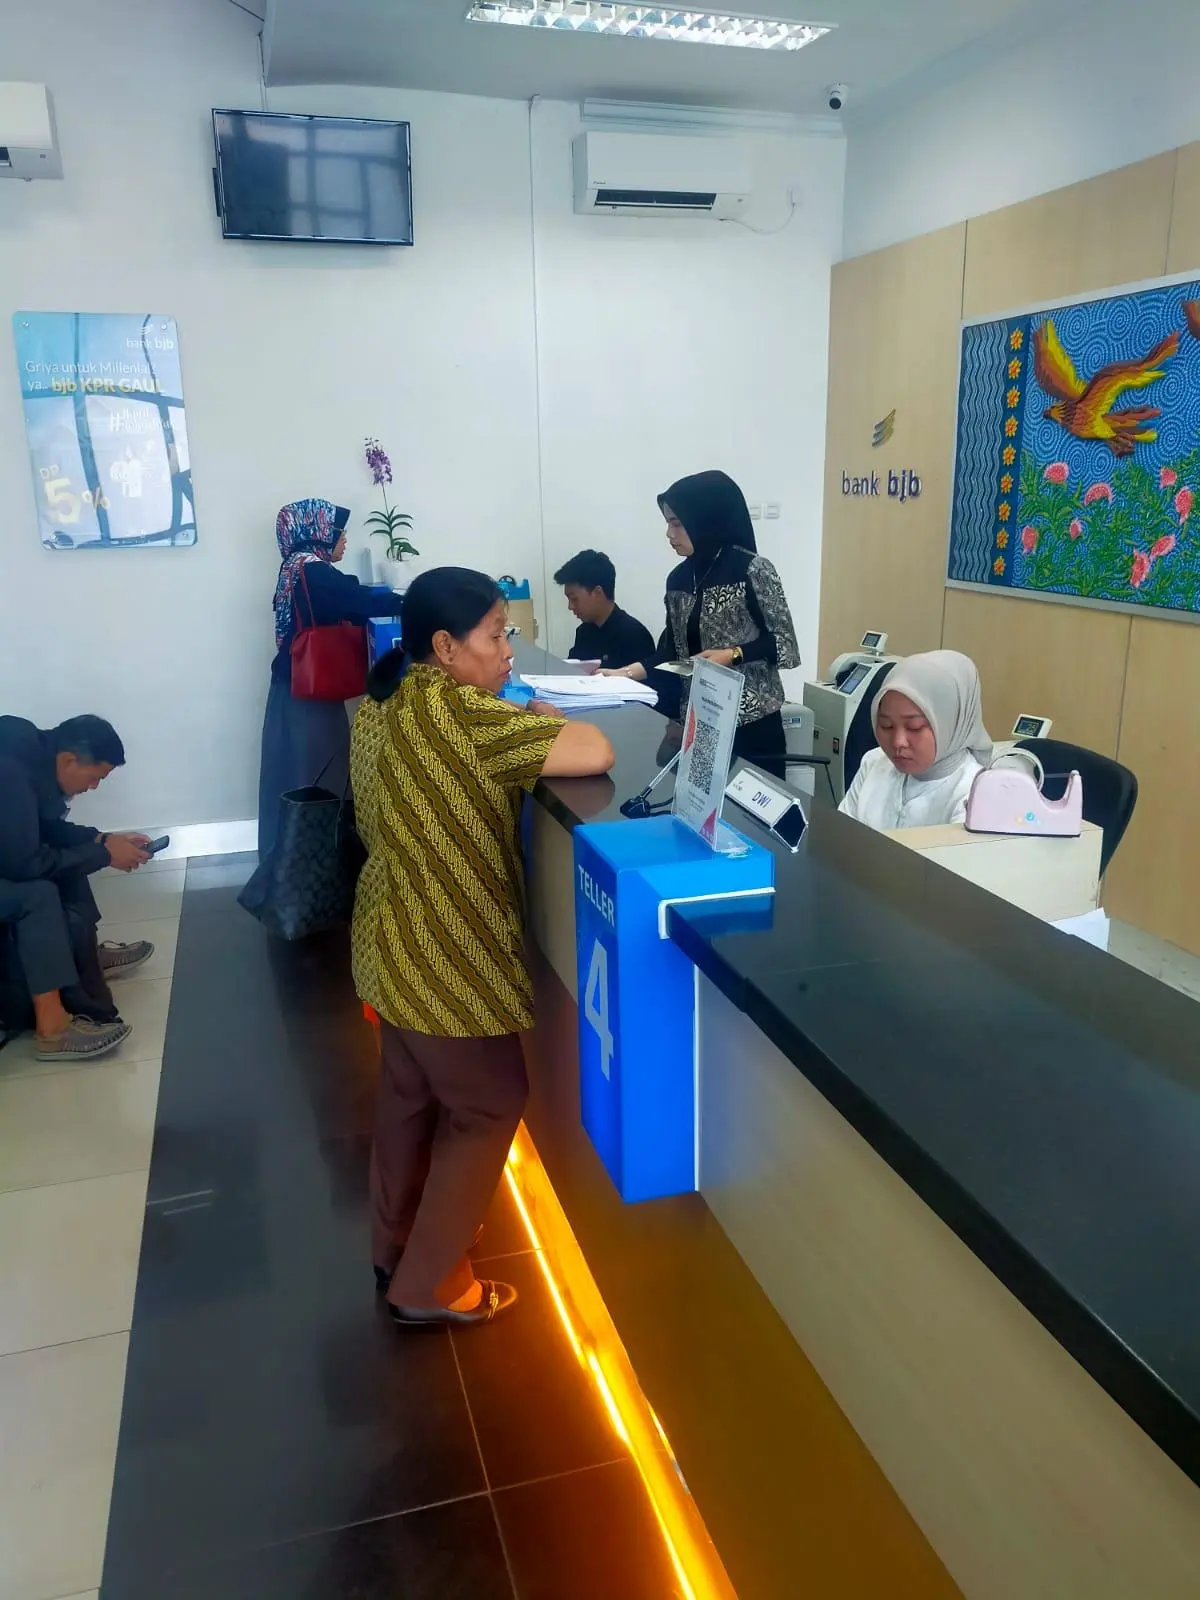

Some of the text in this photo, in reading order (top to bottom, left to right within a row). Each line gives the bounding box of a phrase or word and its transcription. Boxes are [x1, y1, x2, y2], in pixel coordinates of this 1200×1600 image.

[154, 336, 175, 351] bjb
[25, 360, 59, 376] Griya
[61, 360, 97, 374] untuk
[51, 376, 77, 395] bjb
[80, 377, 117, 393] KPR
[118, 377, 165, 393] GAUL
[842, 469, 921, 503] bank bjb
[751, 791, 772, 808] DWI
[578, 865, 615, 927] TELLER
[585, 938, 614, 1081] 4
